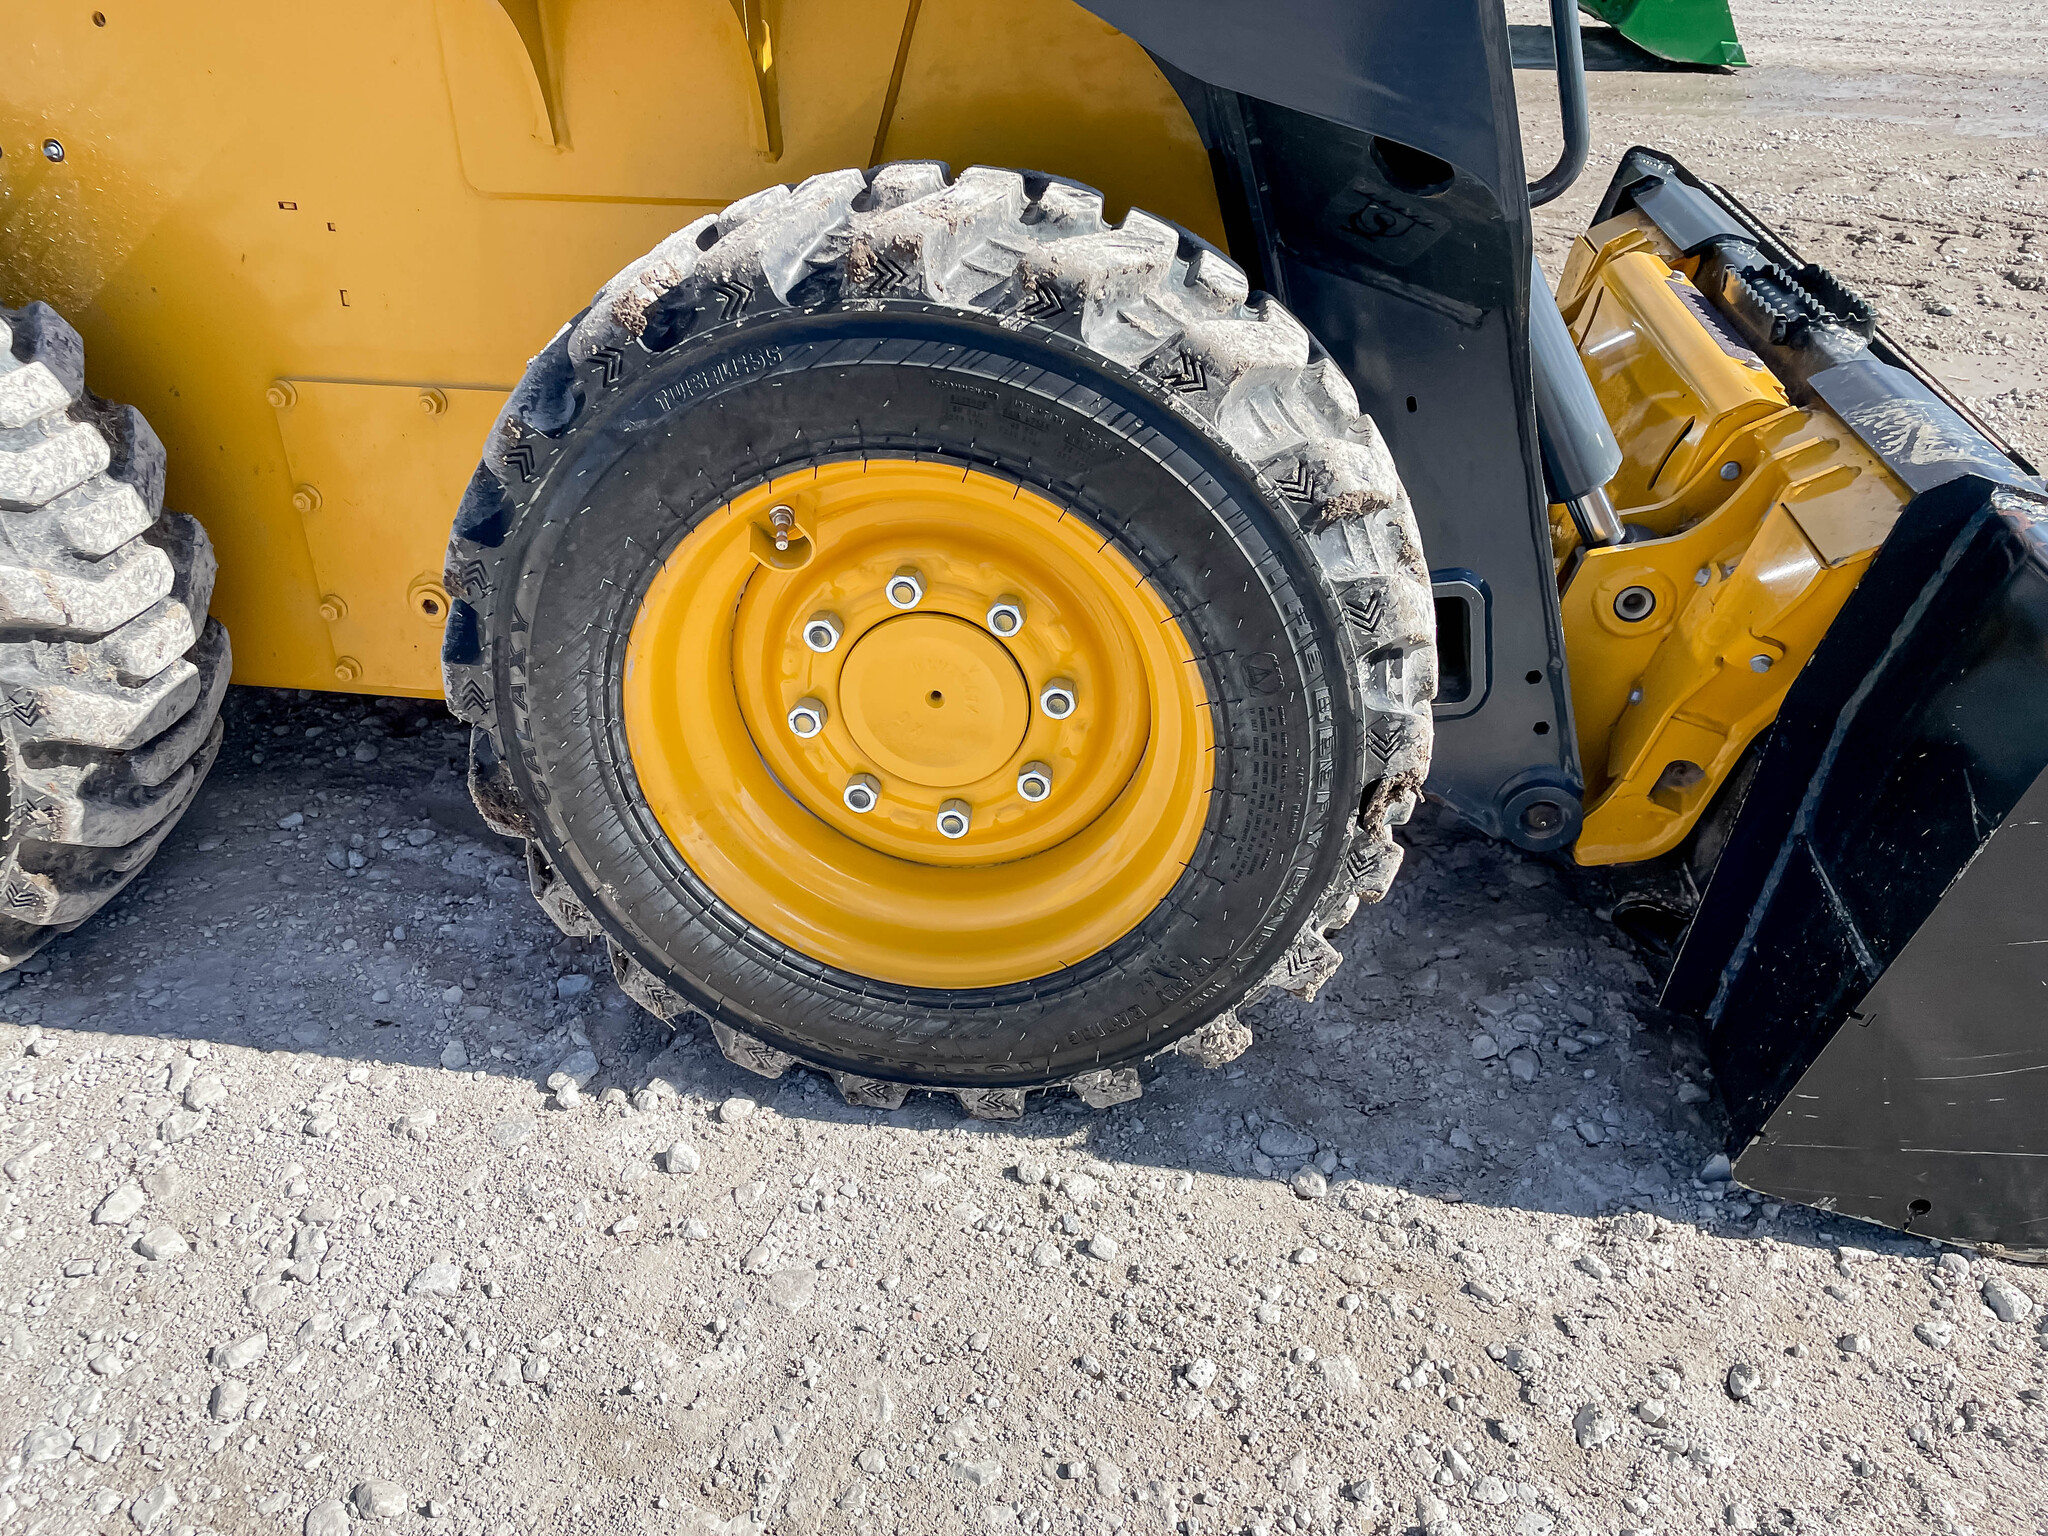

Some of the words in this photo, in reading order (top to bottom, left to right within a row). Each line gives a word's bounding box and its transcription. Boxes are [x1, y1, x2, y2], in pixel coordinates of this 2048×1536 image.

[509, 603, 552, 806] GALAXY
[1306, 685, 1339, 850] BEEFY
[1065, 1003, 1148, 1046] RATING
